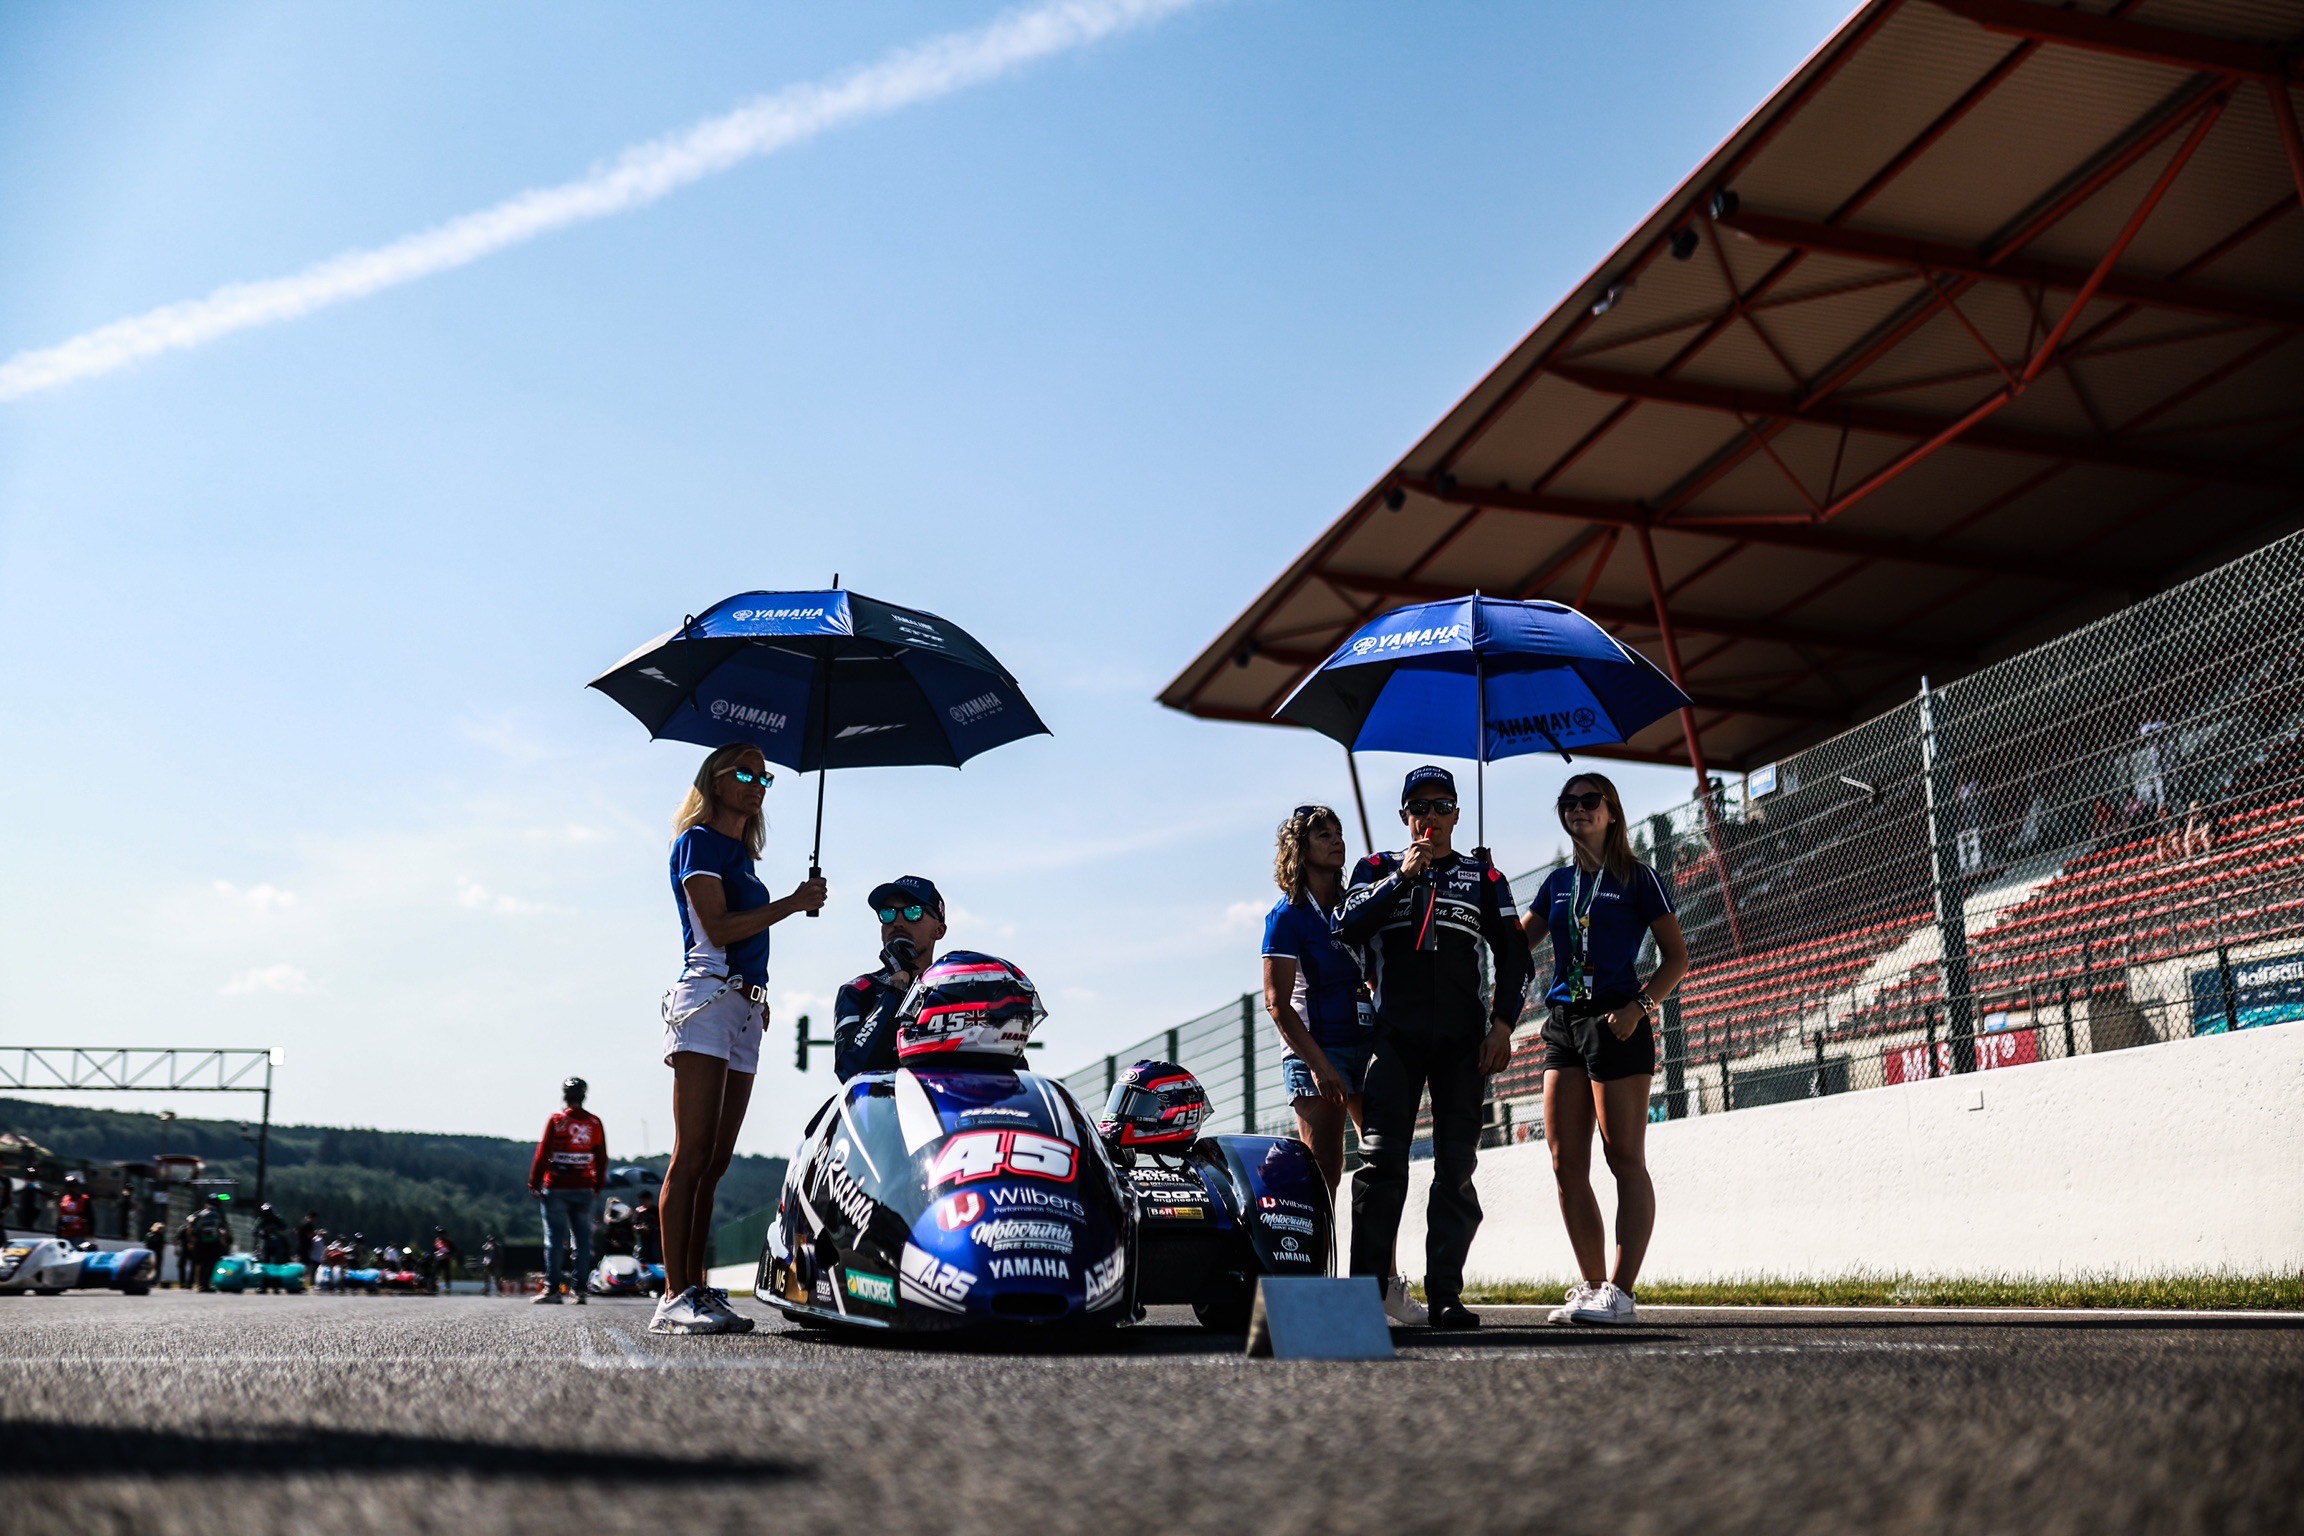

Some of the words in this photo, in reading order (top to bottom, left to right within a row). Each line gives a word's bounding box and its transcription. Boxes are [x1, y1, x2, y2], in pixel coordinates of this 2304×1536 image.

[754, 608, 824, 618] YAMAHA
[1379, 624, 1460, 648] YAMAHA
[729, 703, 787, 730] YAMAHA
[958, 692, 1002, 718] YAMAHA
[1449, 881, 1472, 891] MVT
[927, 1011, 966, 1034] 45
[1172, 1109, 1199, 1126] 45
[929, 1130, 1079, 1191] 45
[822, 1138, 874, 1251] Racing
[989, 1187, 1085, 1217] Wilbers
[1135, 1190, 1206, 1199] VOGT
[1279, 1198, 1314, 1212] Wilbers
[992, 1241, 1023, 1253] BIKE
[1272, 1251, 1312, 1263] YAMAHA
[918, 1256, 979, 1303] ARS
[988, 1257, 1070, 1280] YAMAHA
[856, 1275, 894, 1304] MOTOREX
